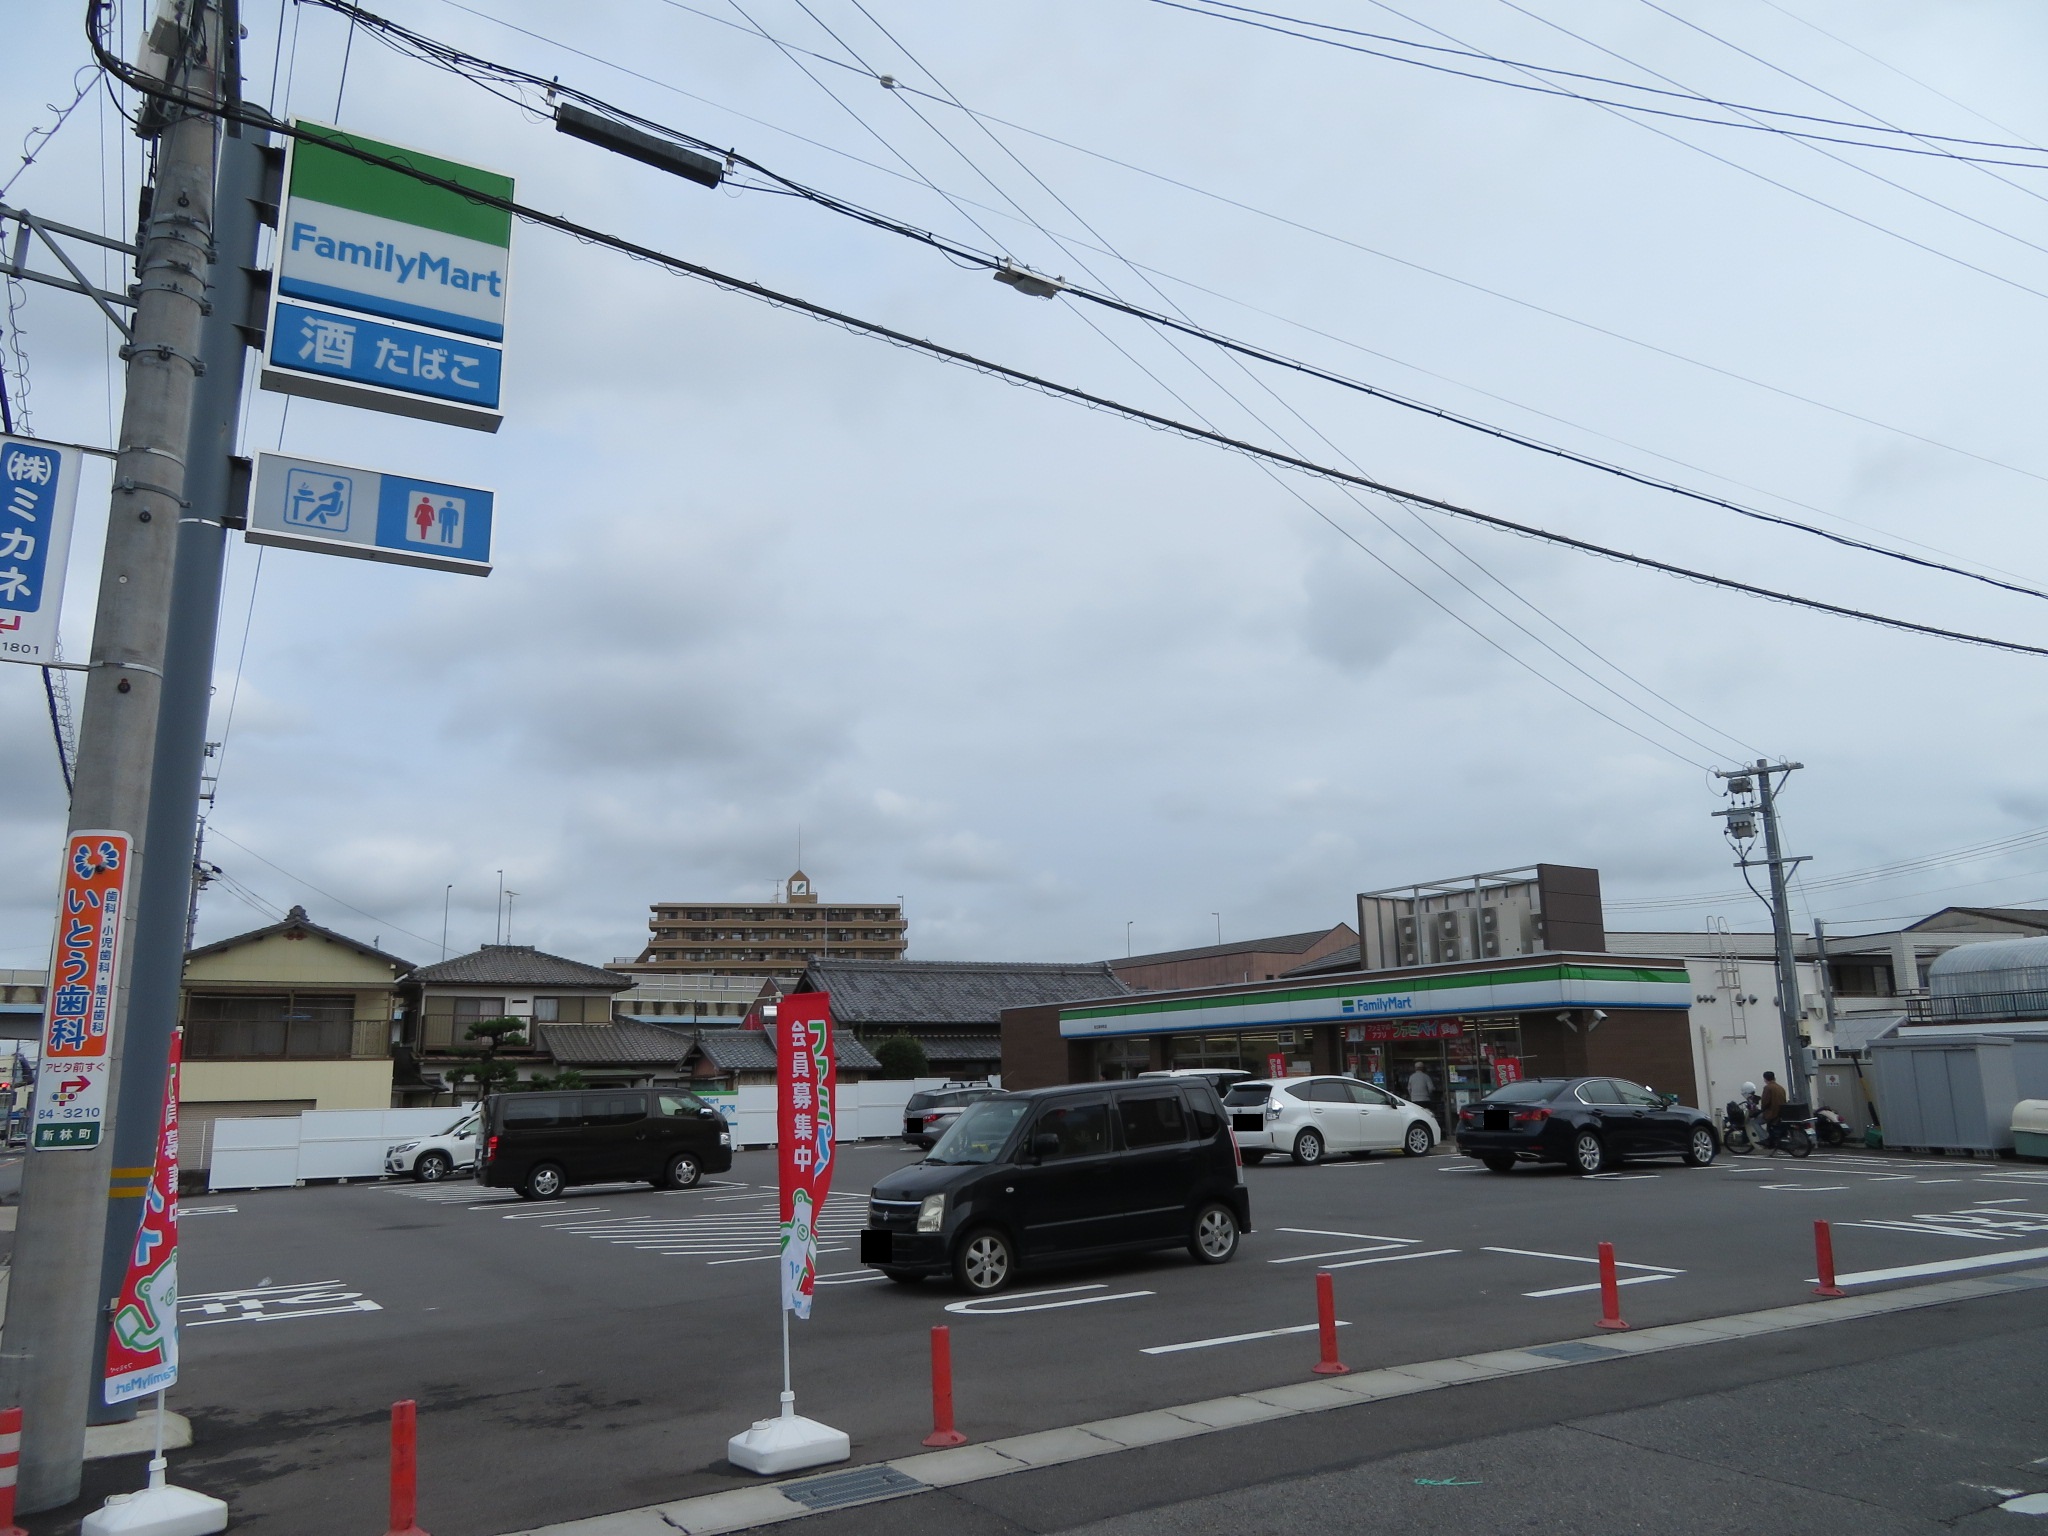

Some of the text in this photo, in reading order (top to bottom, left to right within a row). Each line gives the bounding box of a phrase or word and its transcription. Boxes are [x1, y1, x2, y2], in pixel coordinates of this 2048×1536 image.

[291, 221, 502, 300] FamilyMart
[299, 314, 482, 390] 酒 たばこ
[50, 888, 101, 1051] いとう歯科
[91, 890, 119, 1034] 歯科・小児歯科・矯正歯科
[1357, 995, 1412, 1011] FamilyMart
[1392, 1020, 1438, 1038] ファミペイ
[45, 1062, 106, 1074] アピタ前すぐ
[791, 1020, 813, 1173] 会員募集中
[42, 1129, 92, 1142] 新林町
